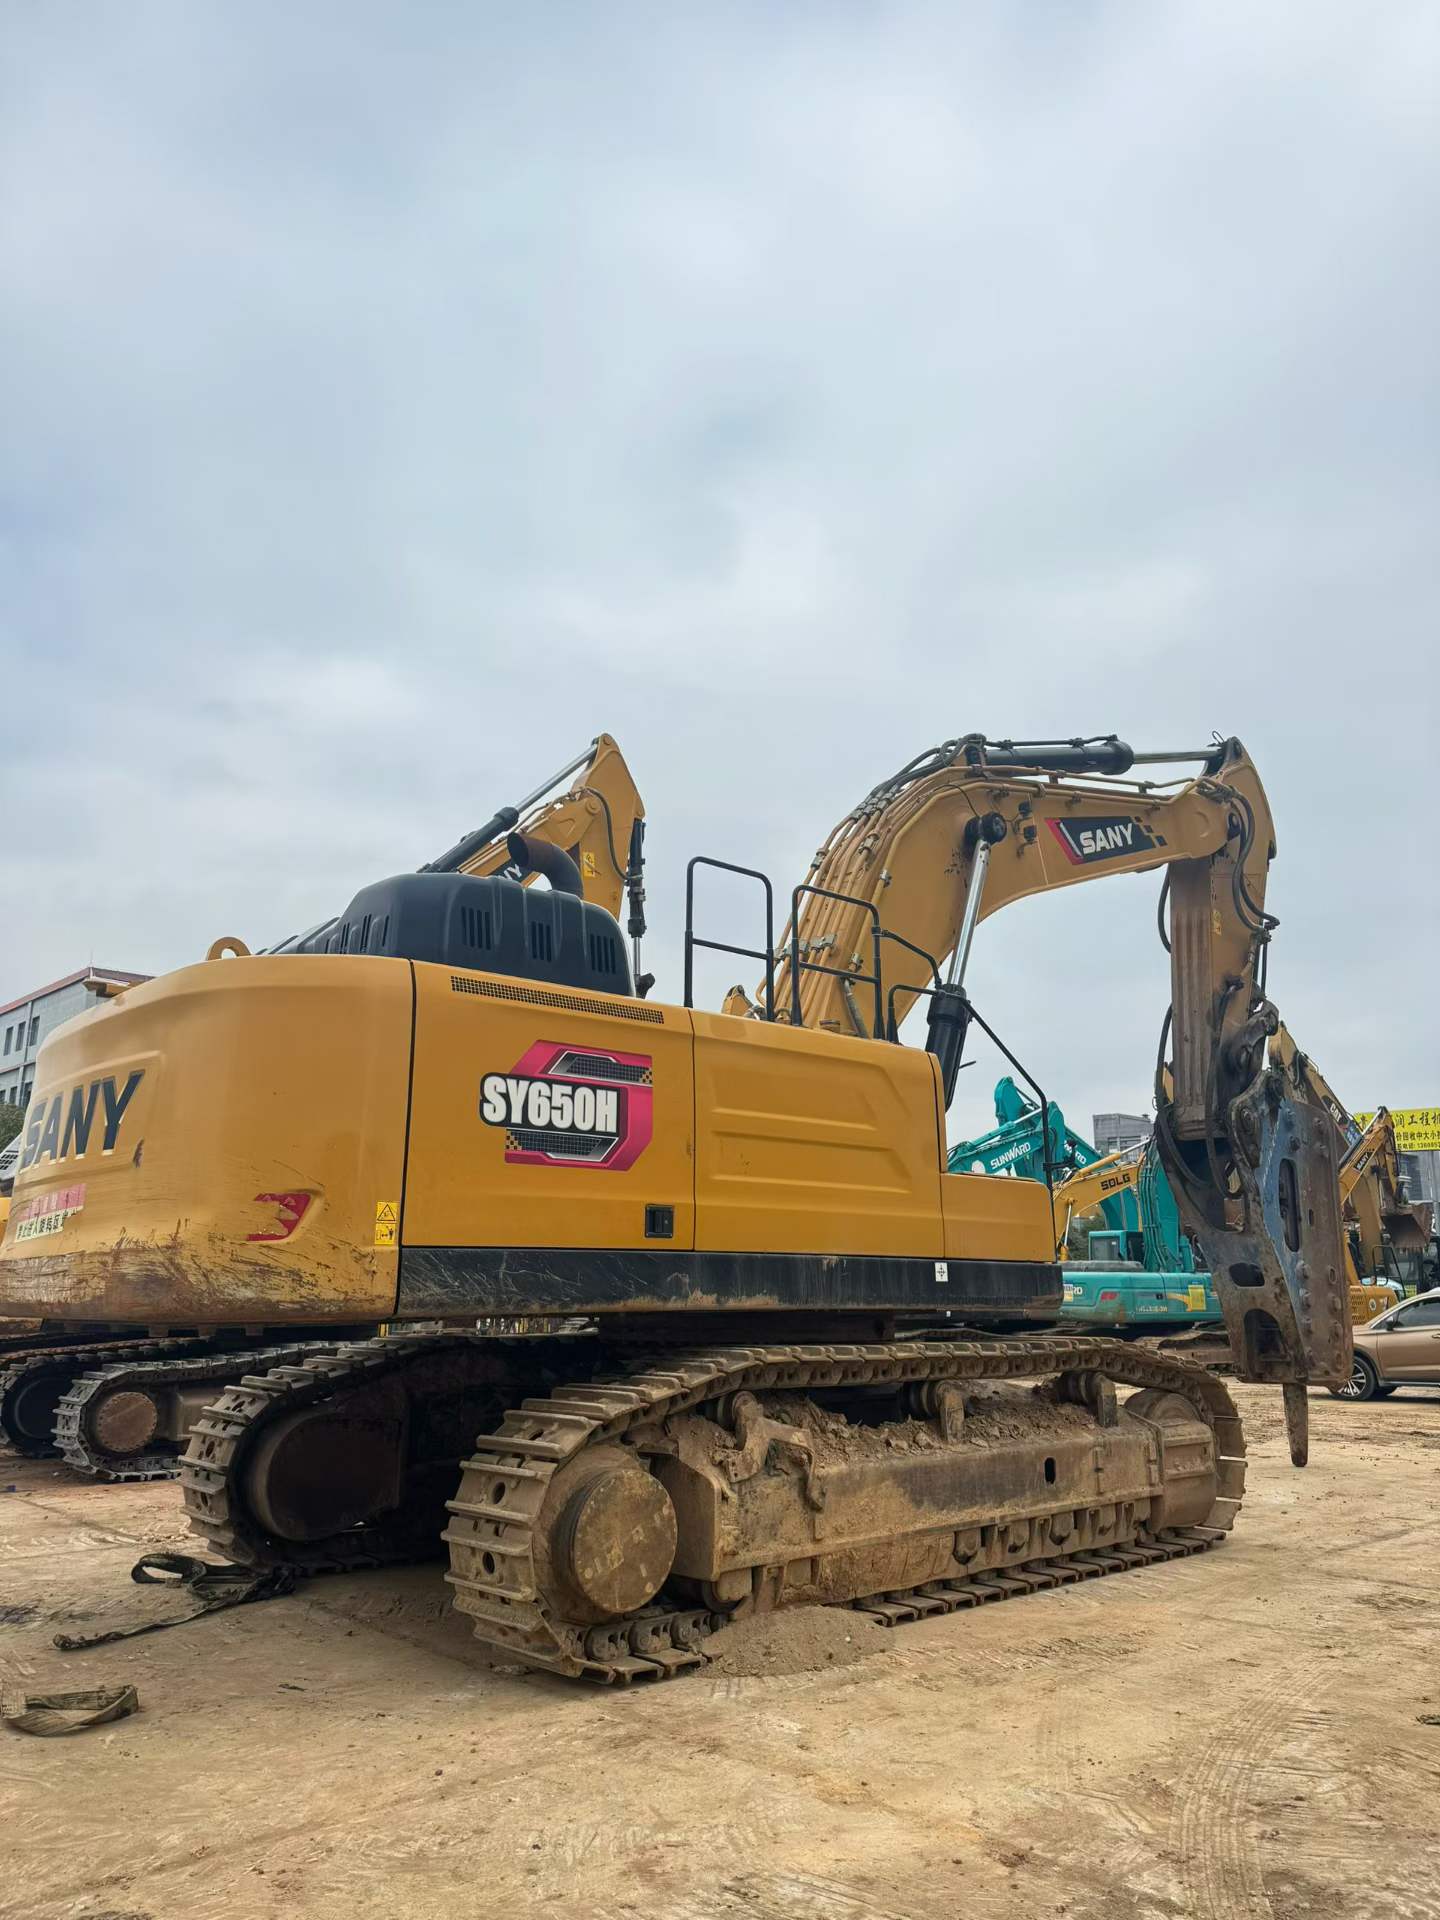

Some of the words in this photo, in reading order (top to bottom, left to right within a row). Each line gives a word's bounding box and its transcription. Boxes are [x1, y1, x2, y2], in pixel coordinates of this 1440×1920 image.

[1079, 822, 1133, 855] SANY
[19, 1069, 146, 1174] SANY
[482, 1075, 618, 1134] SY650H
[990, 1142, 1031, 1170] SUNWARD
